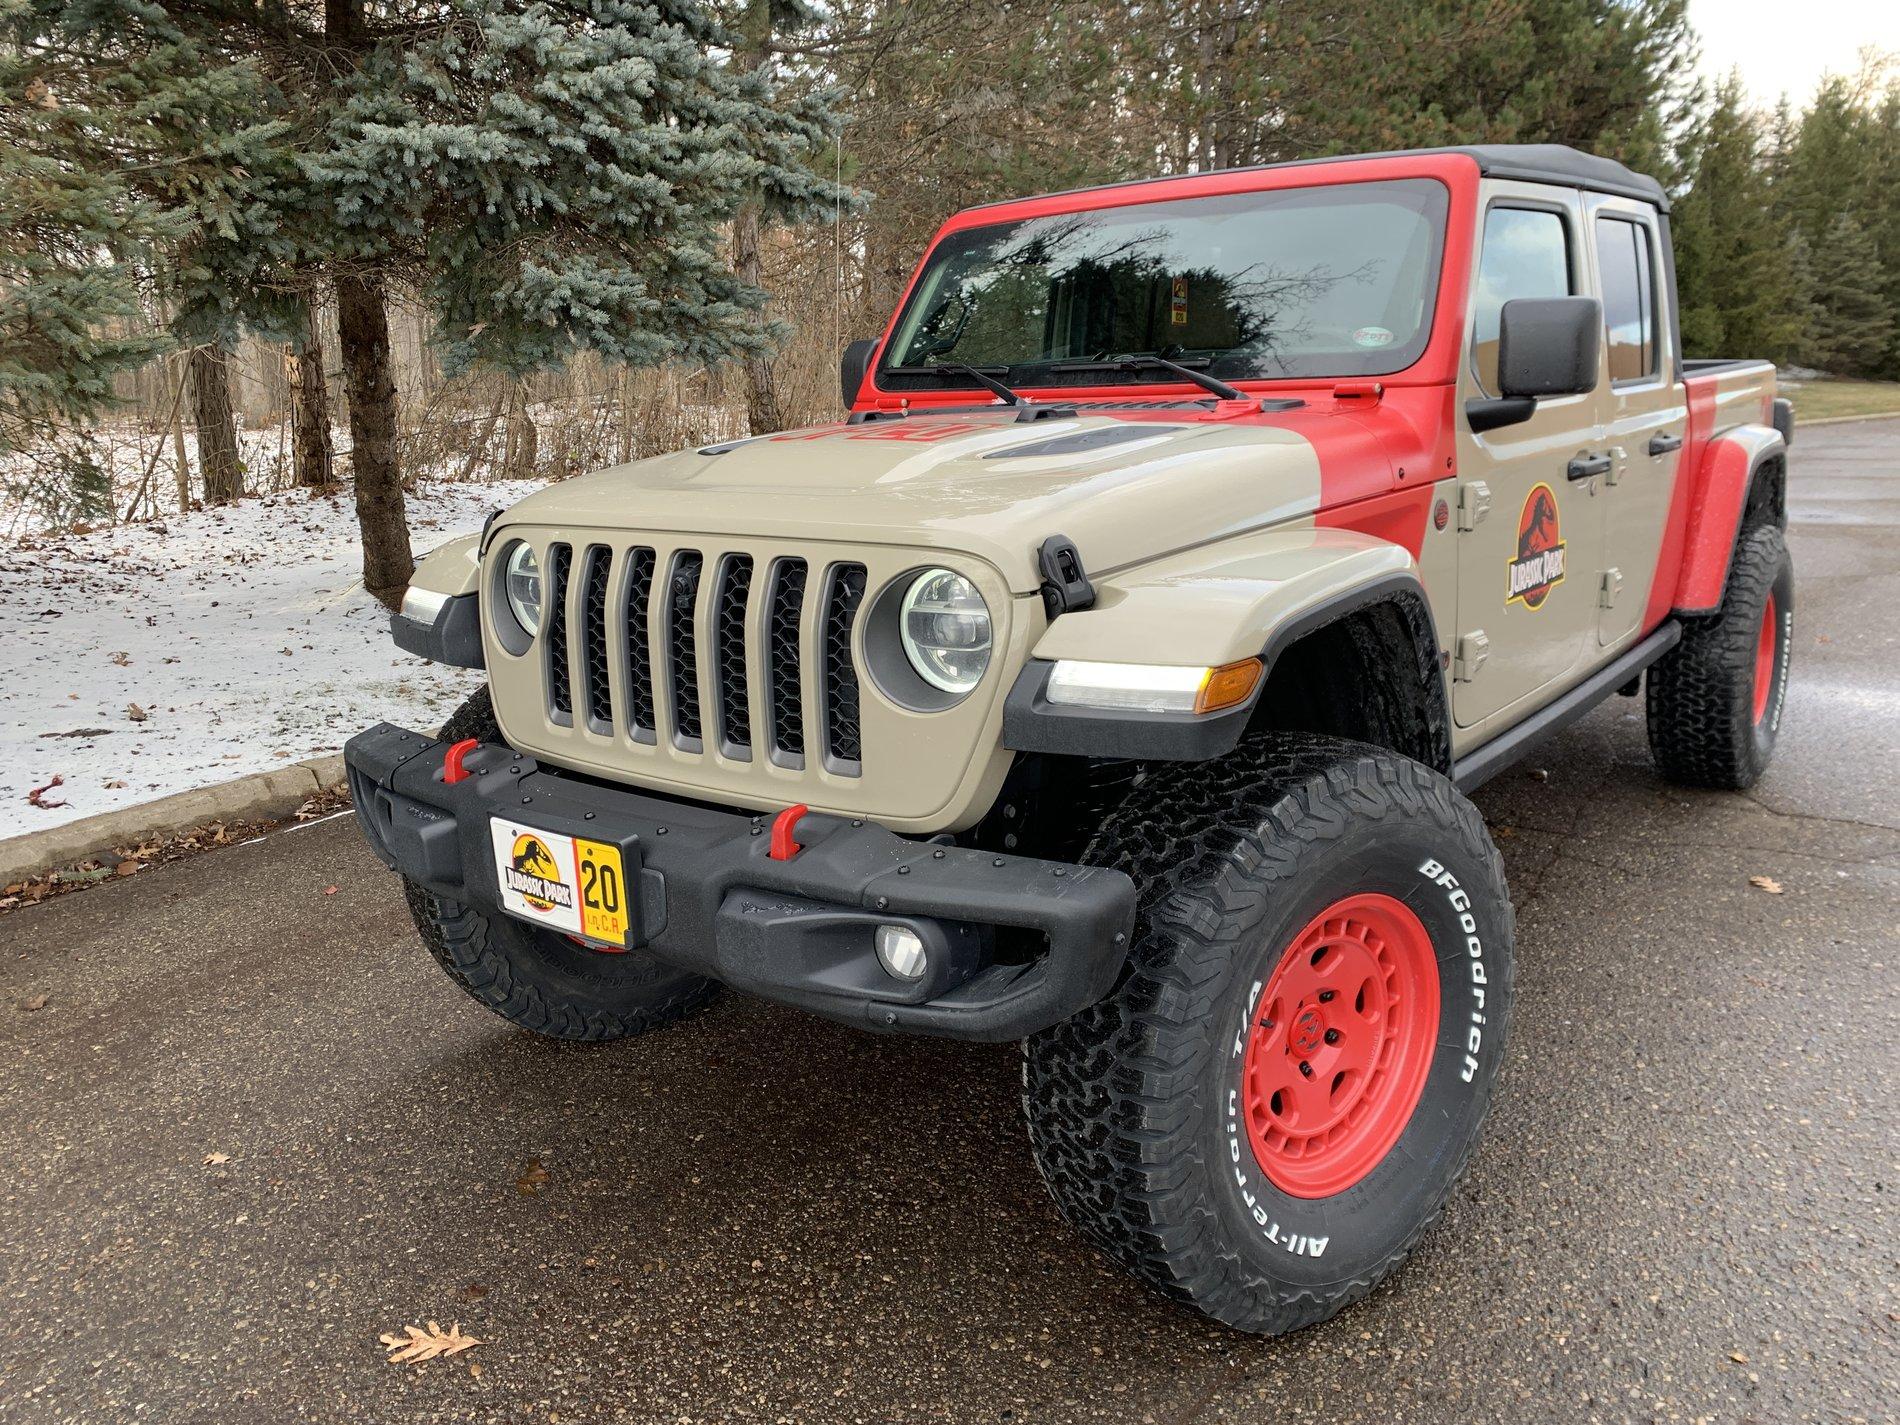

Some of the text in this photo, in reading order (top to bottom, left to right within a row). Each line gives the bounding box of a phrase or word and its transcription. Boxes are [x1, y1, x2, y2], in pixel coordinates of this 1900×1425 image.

[1509, 550, 1564, 598] JURASSIC PARK
[507, 868, 571, 906] JURASSIC PARK
[581, 860, 619, 913] 20
[1419, 859, 1487, 1083] BFGoodrich
[1227, 981, 1329, 1258] All-Terrain T/A
